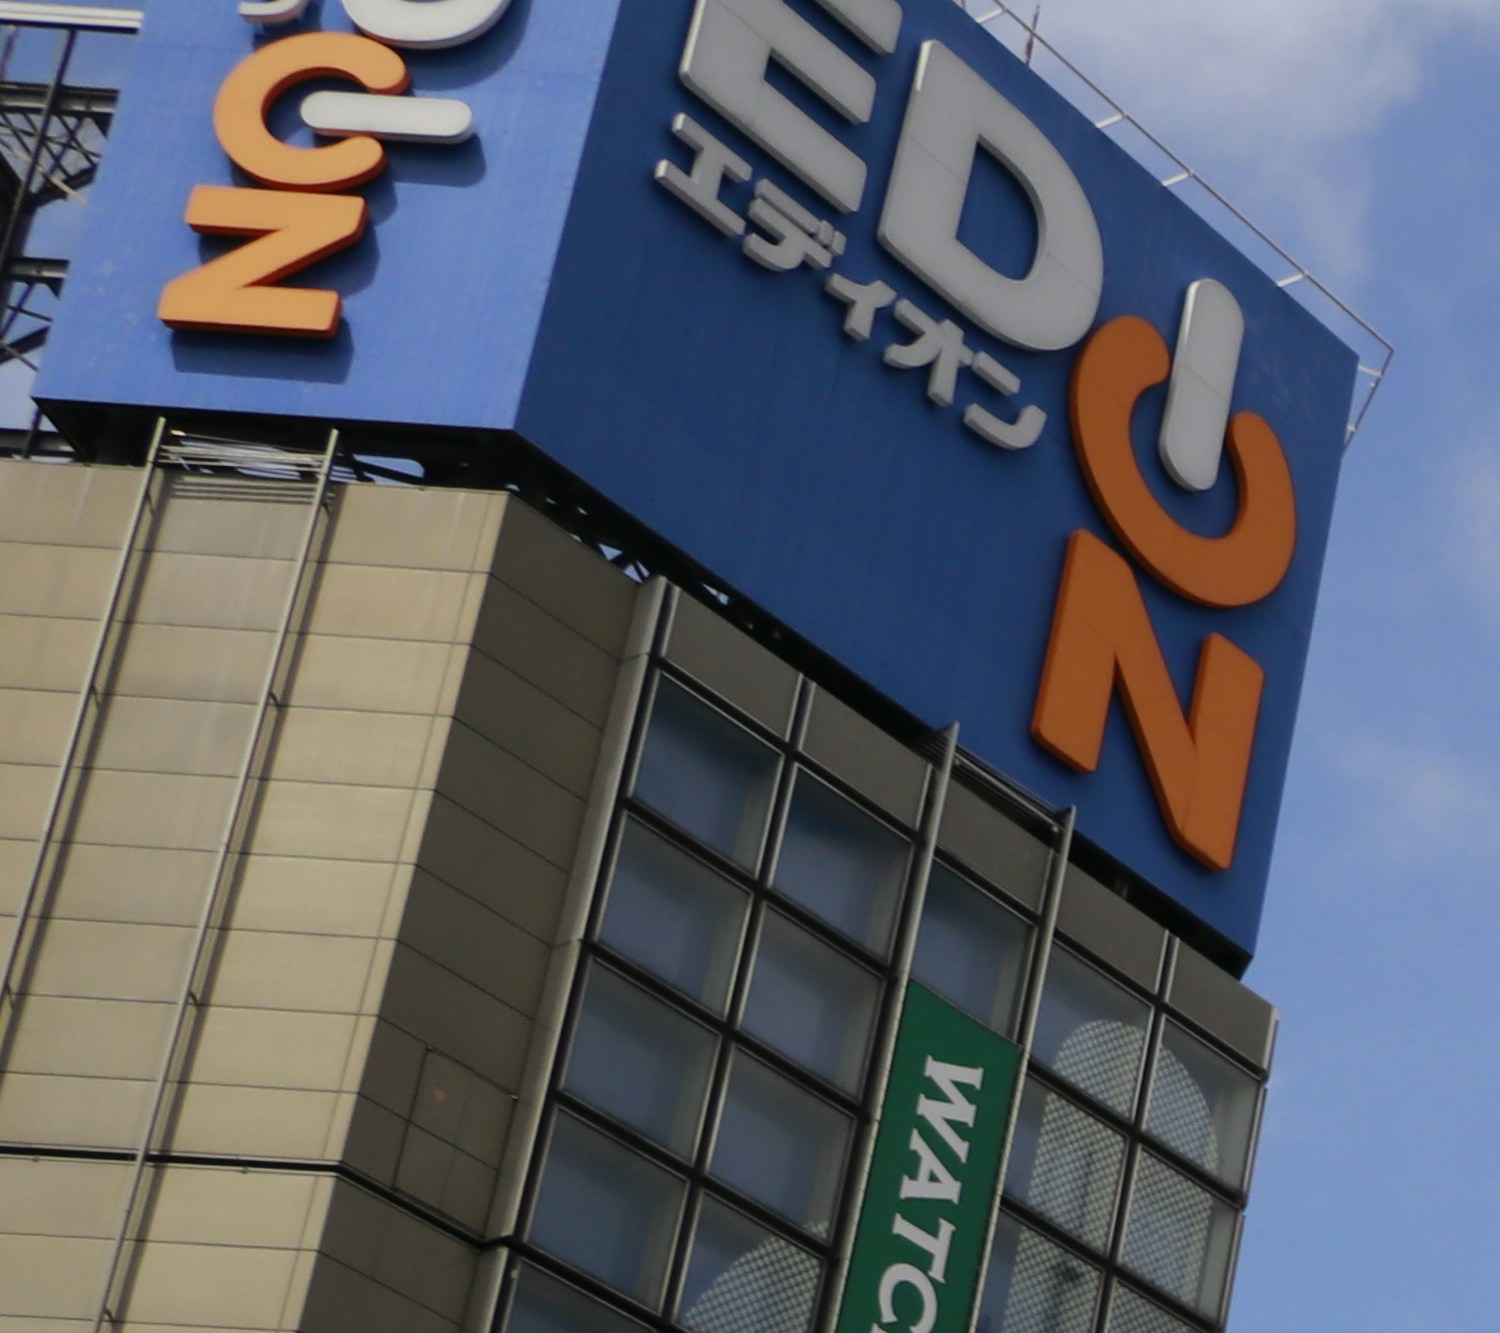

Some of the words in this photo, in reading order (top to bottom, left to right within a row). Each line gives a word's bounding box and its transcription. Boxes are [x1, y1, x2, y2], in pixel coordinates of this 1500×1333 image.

[654, 112, 1046, 452] エディオン
[680, 0, 1297, 870] EDION
